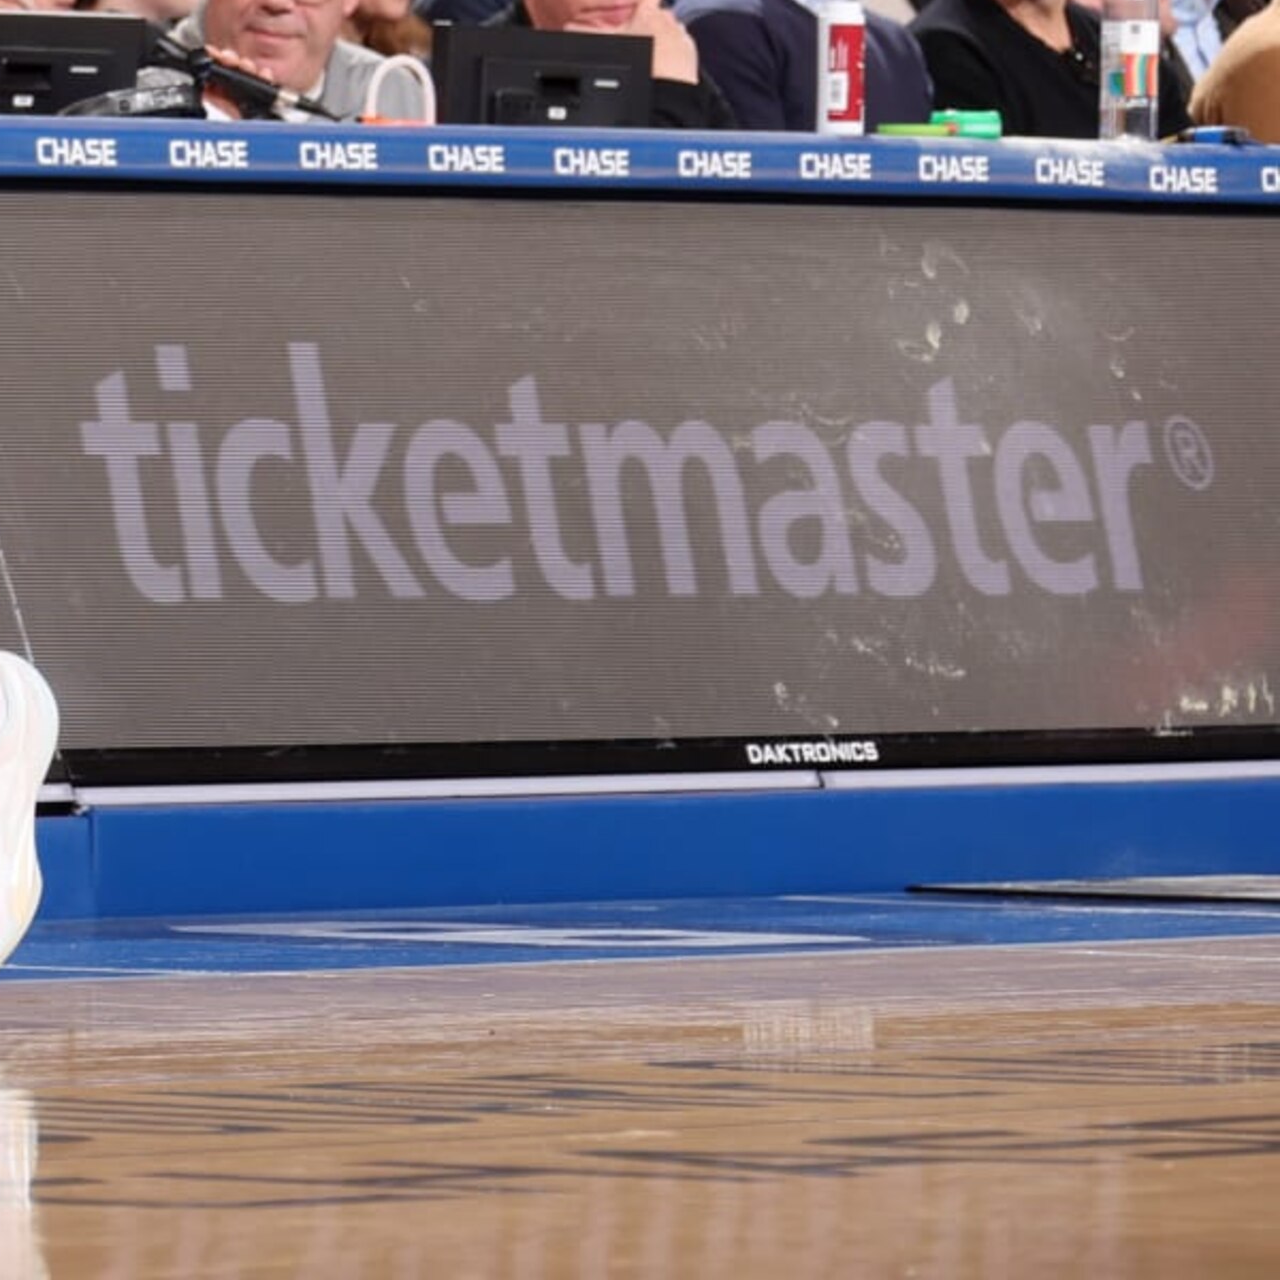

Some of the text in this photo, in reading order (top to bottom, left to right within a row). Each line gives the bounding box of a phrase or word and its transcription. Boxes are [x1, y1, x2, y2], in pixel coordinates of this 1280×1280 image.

[35, 136, 118, 168] CHASE
[168, 139, 250, 169] CHASE
[299, 141, 379, 171] CHASE
[427, 144, 506, 174] CHASE
[553, 147, 630, 177] CHASE
[677, 150, 753, 180] CHASE
[799, 152, 872, 181] CHASE
[917, 154, 990, 184] CHASE
[1034, 156, 1106, 188] CHASE
[1149, 165, 1218, 194] CHASE
[745, 740, 880, 765] DAKTRONICS
